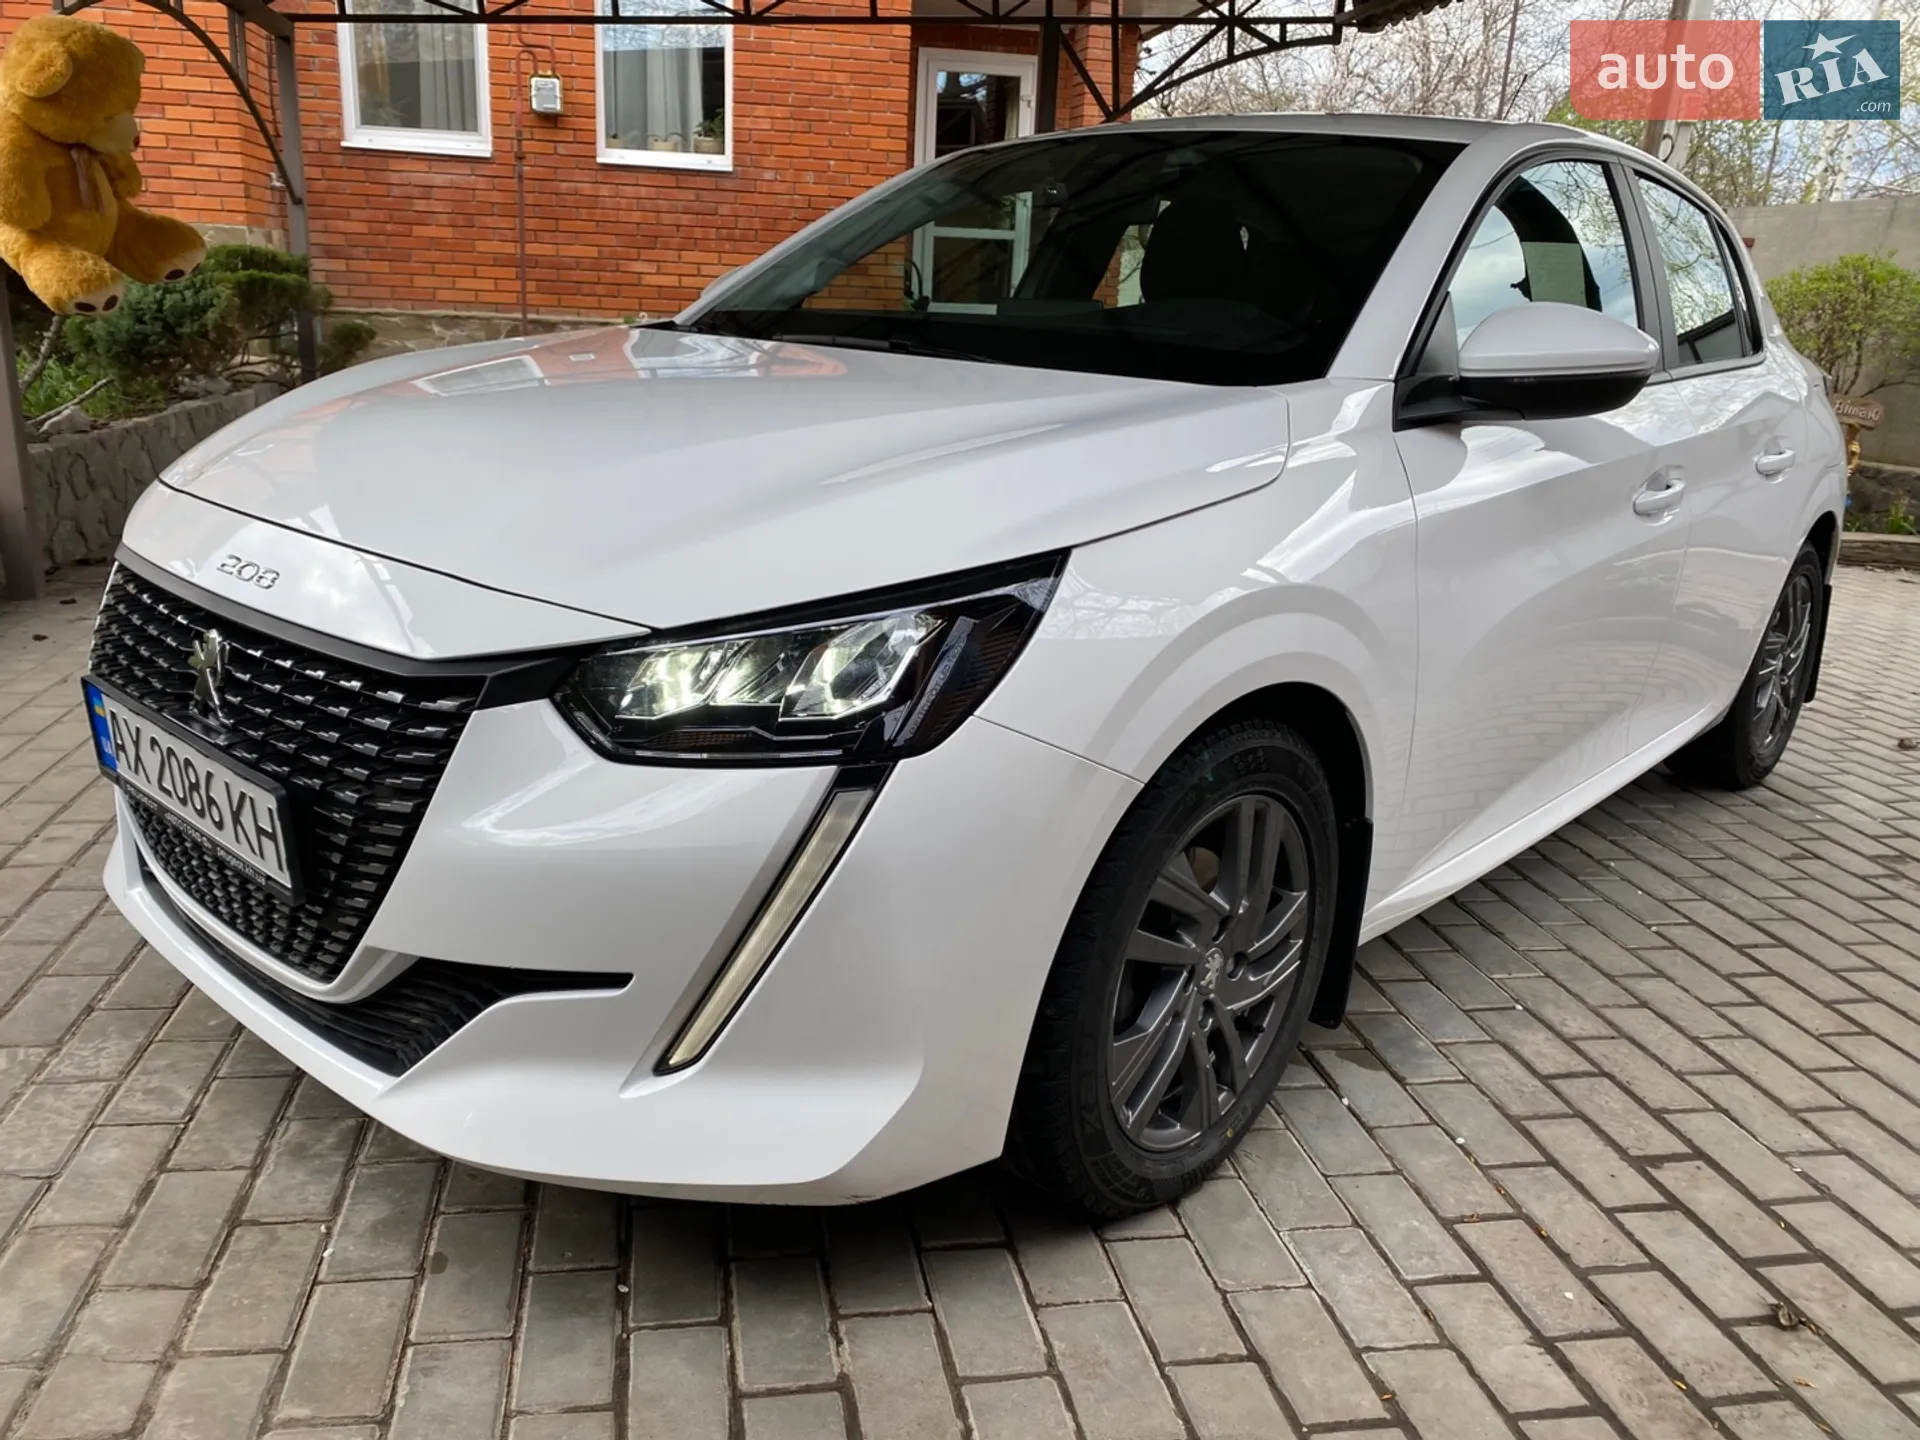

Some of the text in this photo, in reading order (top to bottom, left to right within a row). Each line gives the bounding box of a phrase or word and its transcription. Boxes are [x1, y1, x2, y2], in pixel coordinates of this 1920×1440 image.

[216, 554, 281, 590] 208
[101, 736, 114, 757] UA
[110, 709, 285, 873] AX 2086 KH
